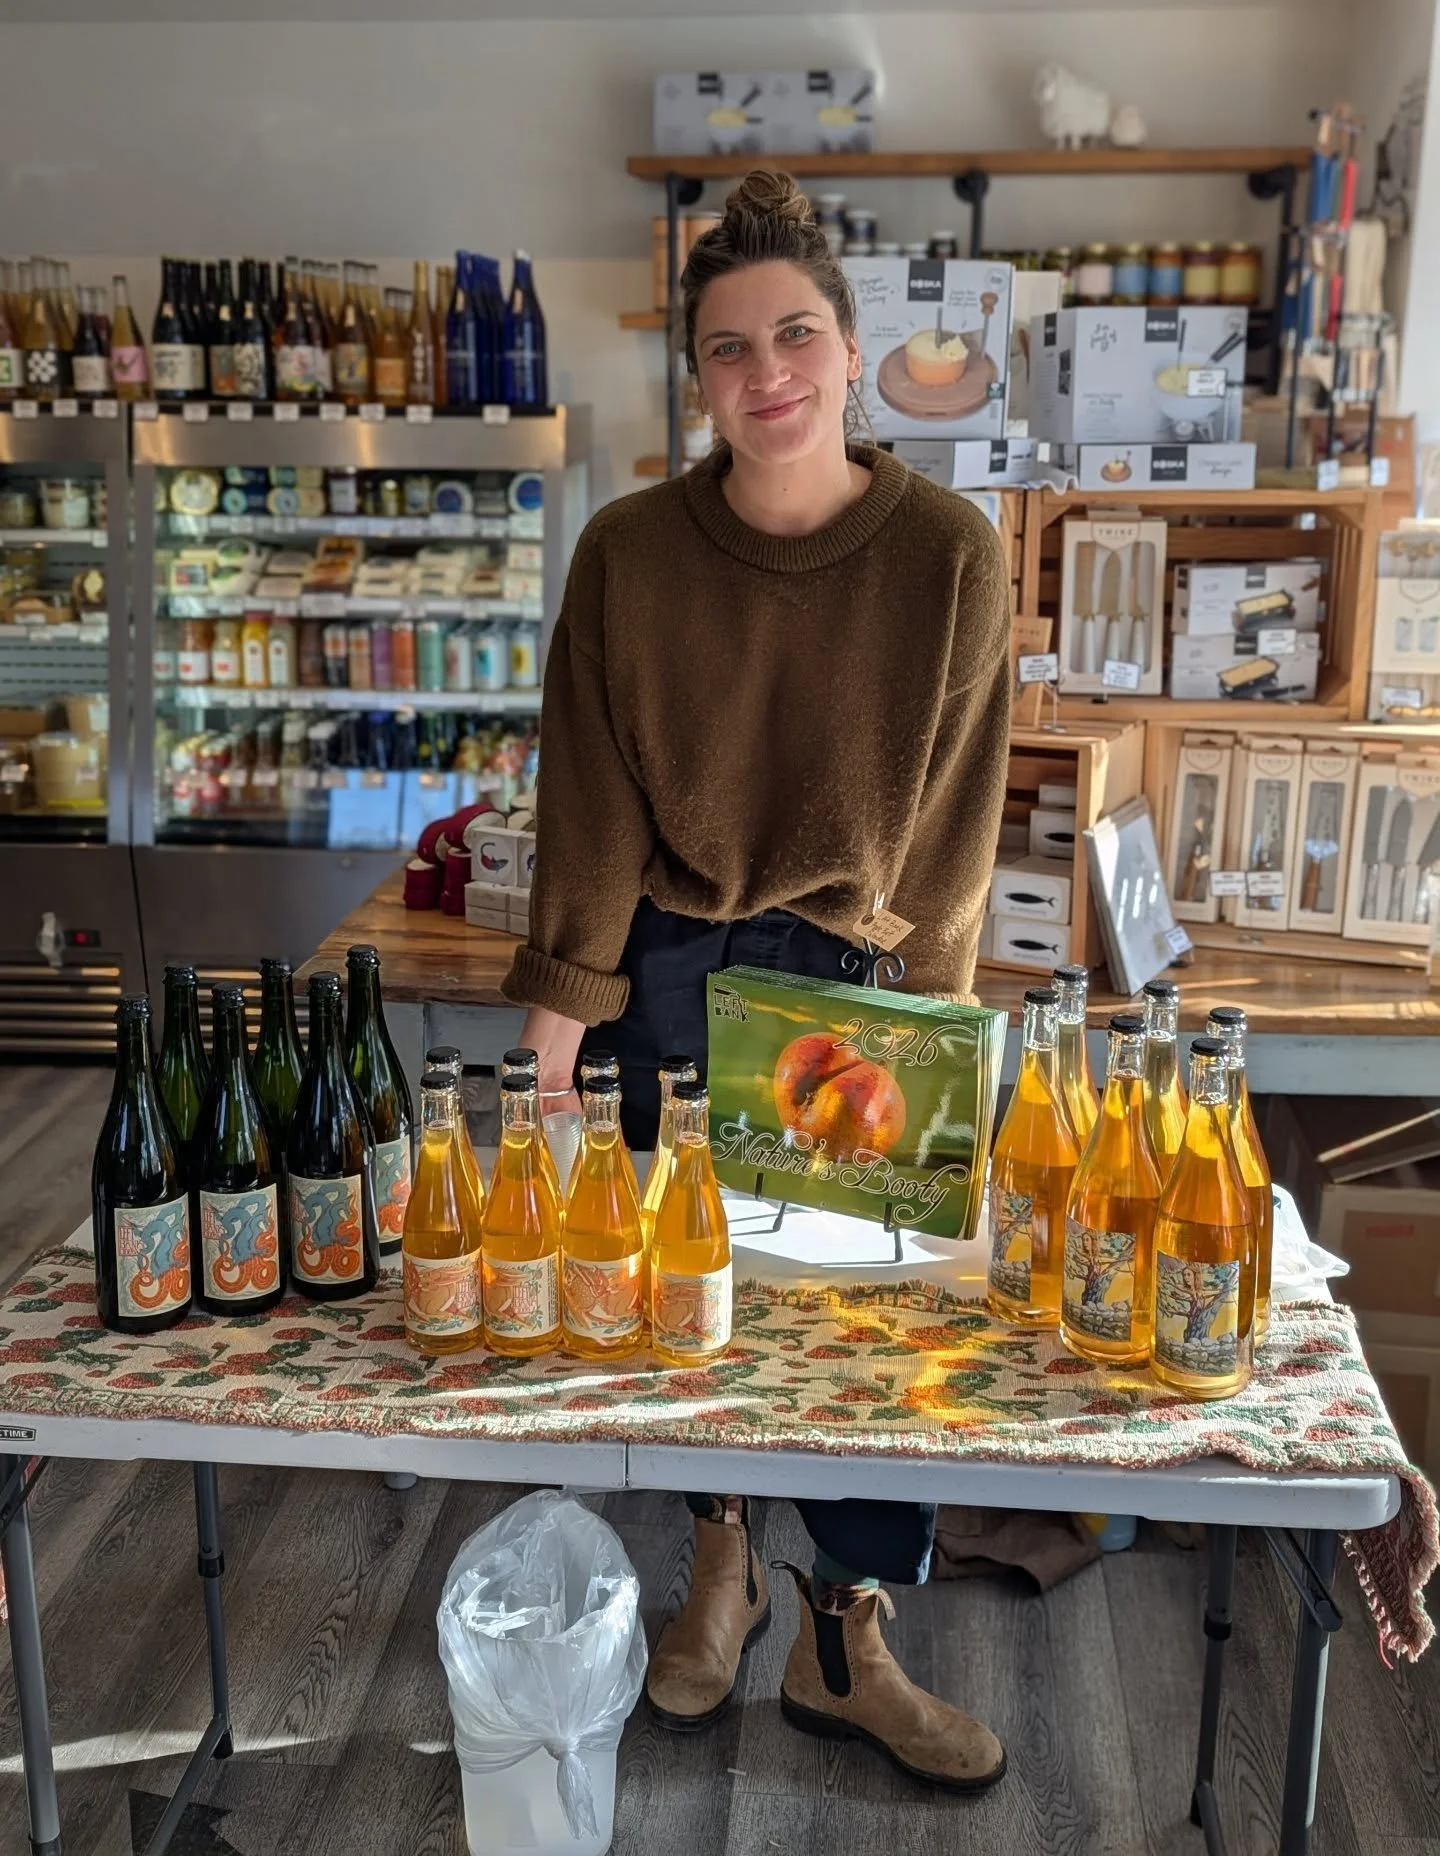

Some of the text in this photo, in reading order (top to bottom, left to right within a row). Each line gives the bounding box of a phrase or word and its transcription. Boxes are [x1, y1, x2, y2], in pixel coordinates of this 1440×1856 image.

[714, 993, 748, 1010] LEFT
[715, 1006, 749, 1022] BANK
[832, 1017, 977, 1067] 2026
[709, 1121, 971, 1224] Nature's Booty
[0, 1429, 28, 1438] TIME
